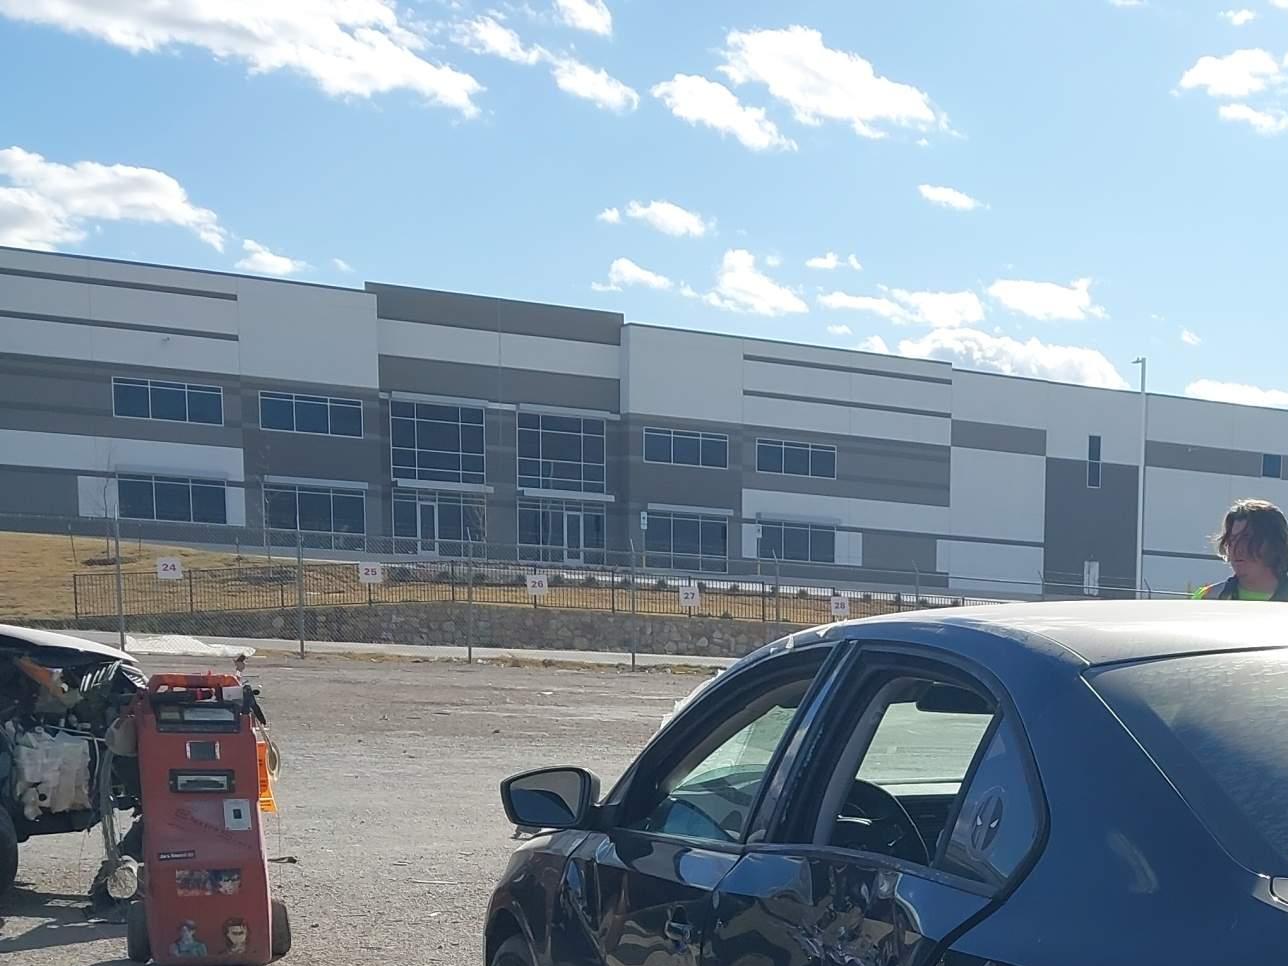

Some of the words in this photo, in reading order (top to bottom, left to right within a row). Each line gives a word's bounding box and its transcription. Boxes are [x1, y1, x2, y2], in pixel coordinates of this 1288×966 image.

[161, 563, 177, 572] 24
[364, 567, 378, 576] 25
[531, 580, 544, 589] 26
[683, 591, 695, 600] 27
